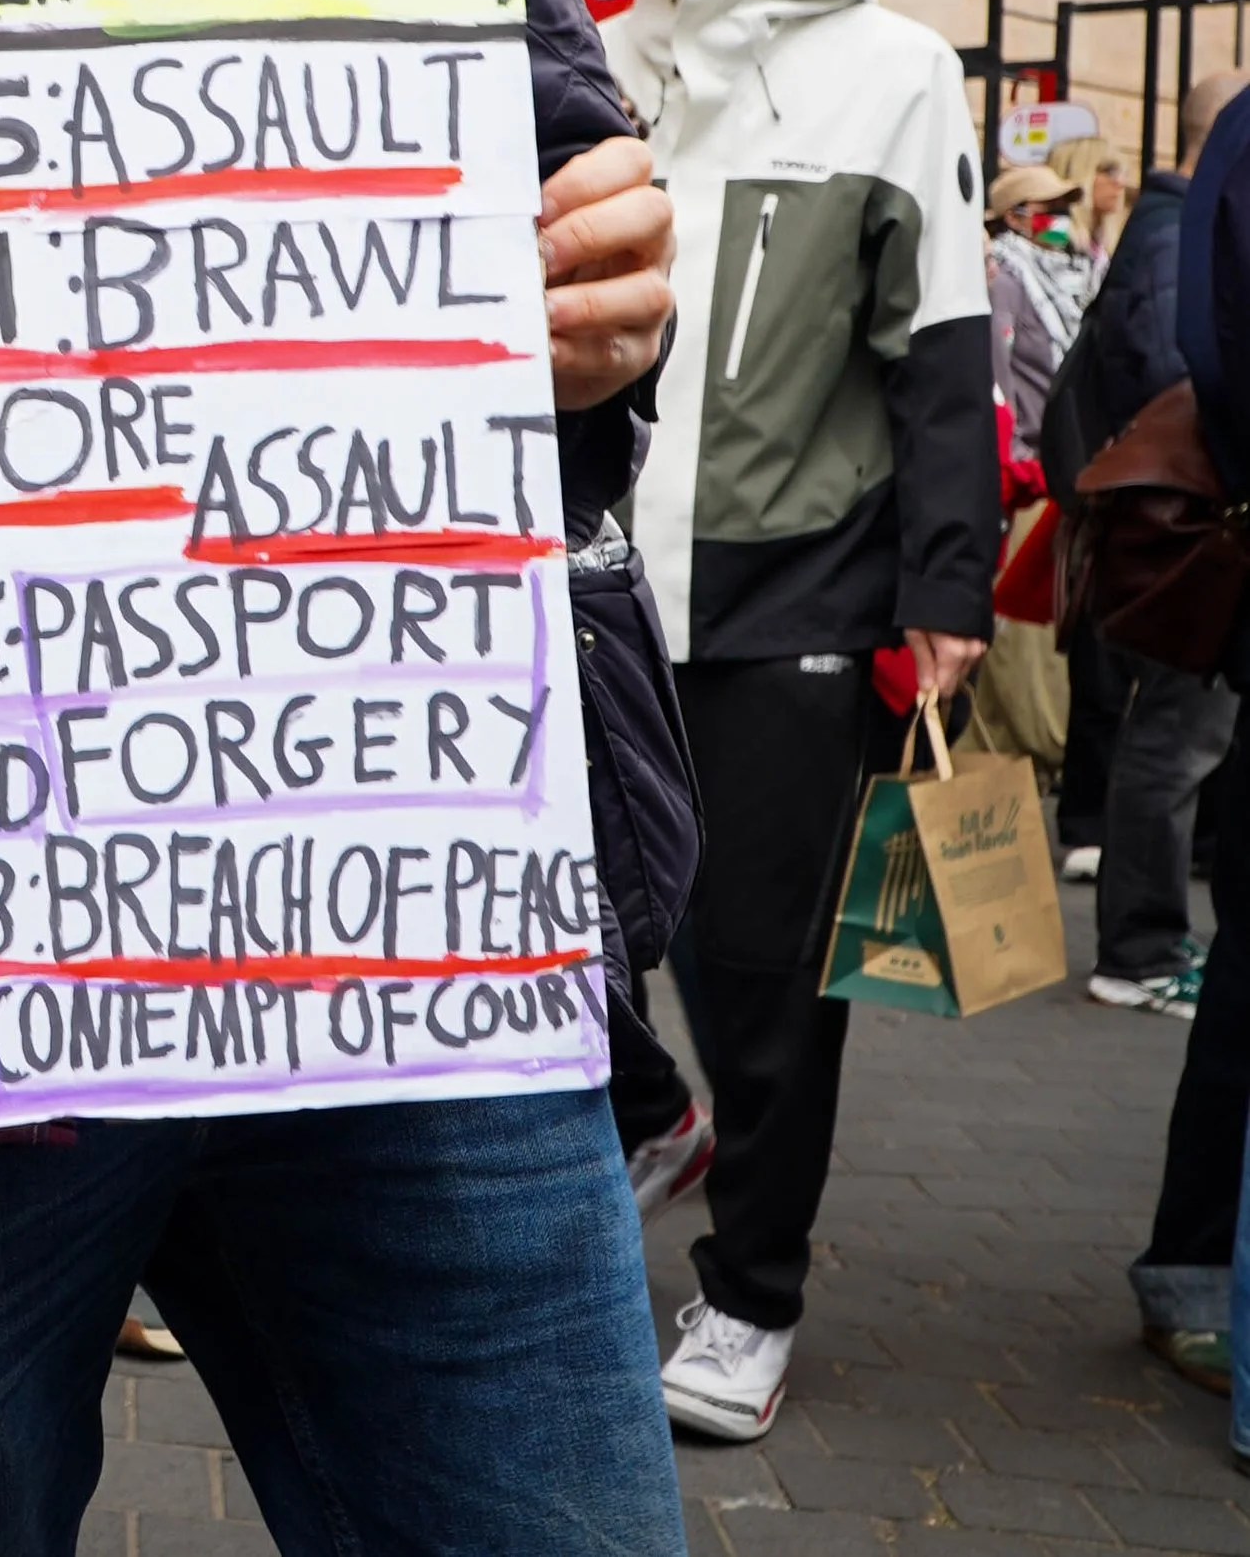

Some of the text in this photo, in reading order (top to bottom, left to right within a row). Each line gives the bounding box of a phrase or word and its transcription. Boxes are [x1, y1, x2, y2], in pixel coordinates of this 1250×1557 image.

[191, 413, 558, 551] ASSAULT
[57, 686, 551, 818] FORGERY
[45, 830, 315, 966] BREACH
[327, 844, 433, 963] OF
[445, 838, 600, 957] PEACE
[327, 976, 418, 1068] OF
[426, 955, 608, 1048] COURT
